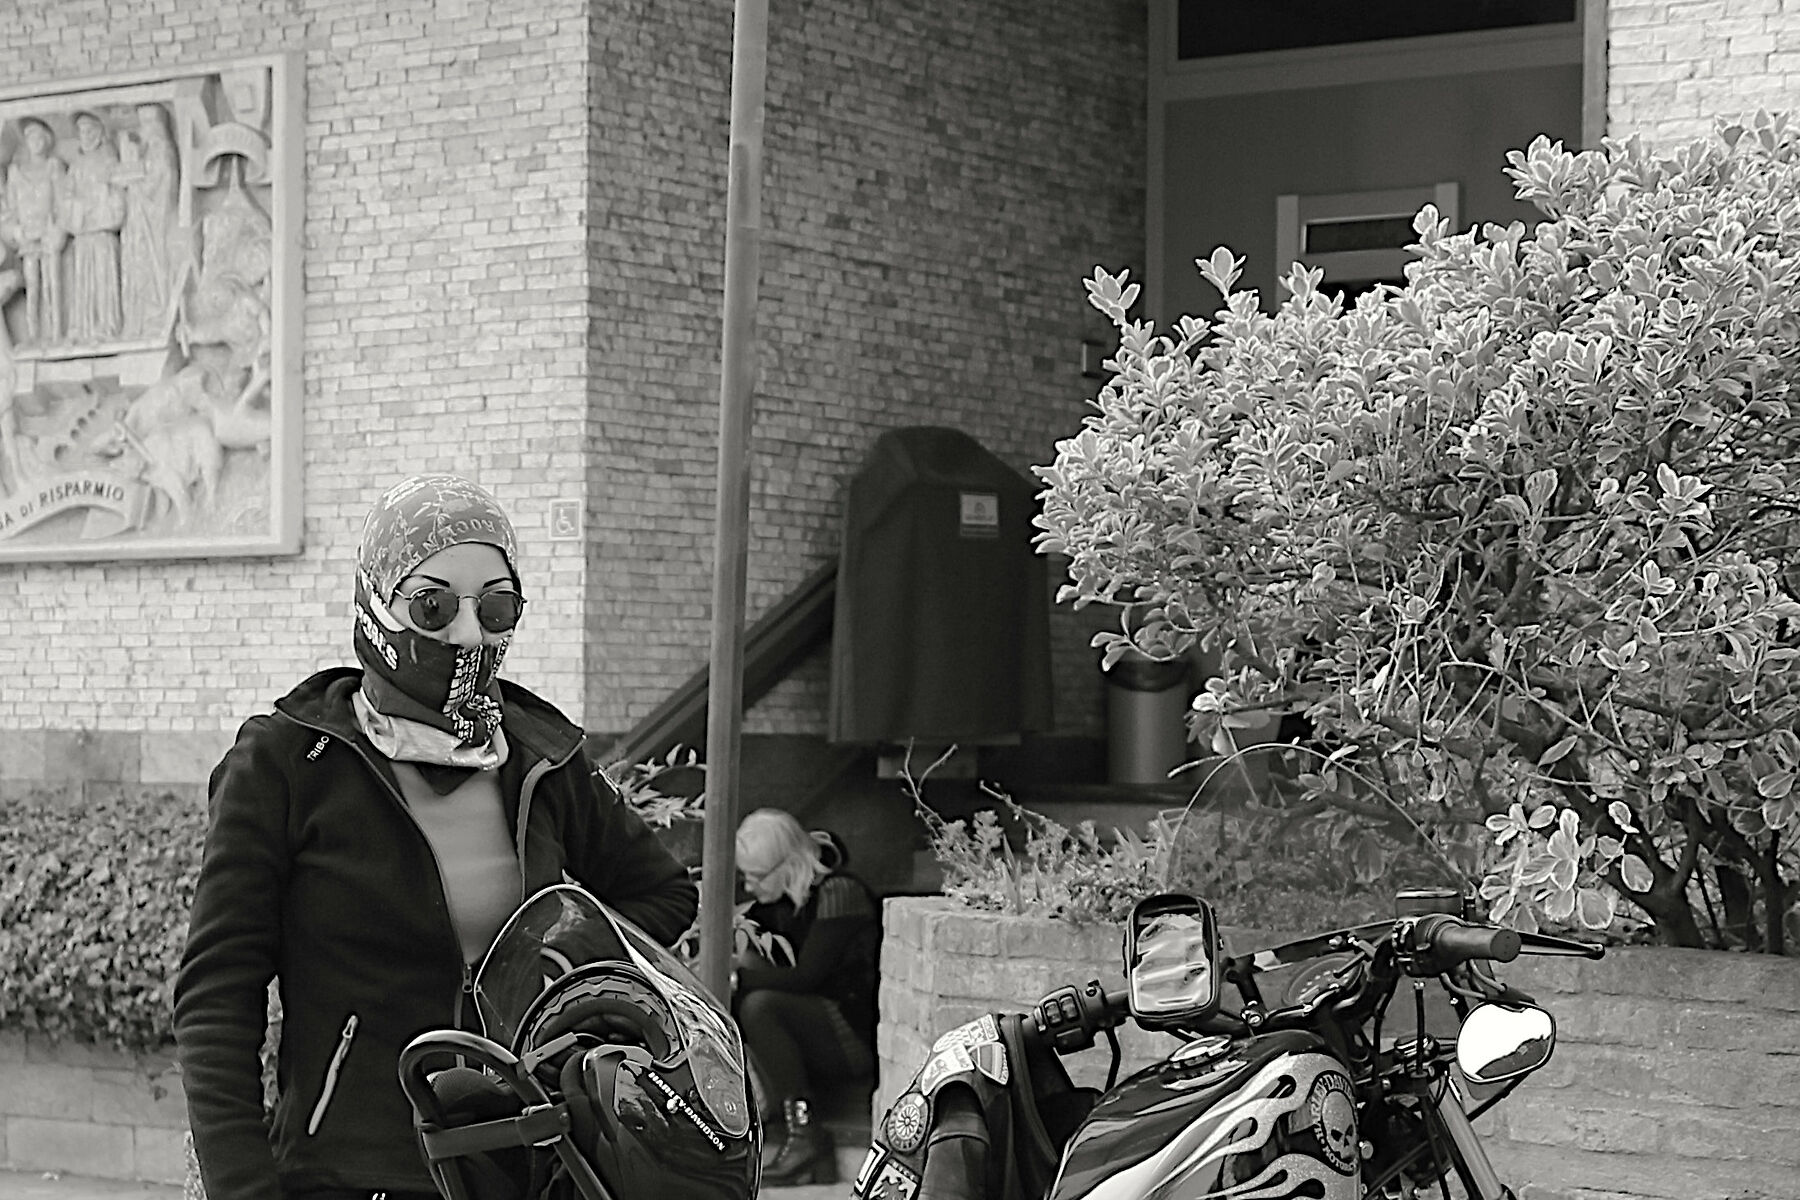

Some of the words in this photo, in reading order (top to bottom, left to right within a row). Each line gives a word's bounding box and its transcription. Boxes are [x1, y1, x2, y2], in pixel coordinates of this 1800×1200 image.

[20, 502, 34, 517] DI
[39, 480, 125, 507] RISPARMIO
[647, 1071, 726, 1152] HARLEY-DAVIDSON
